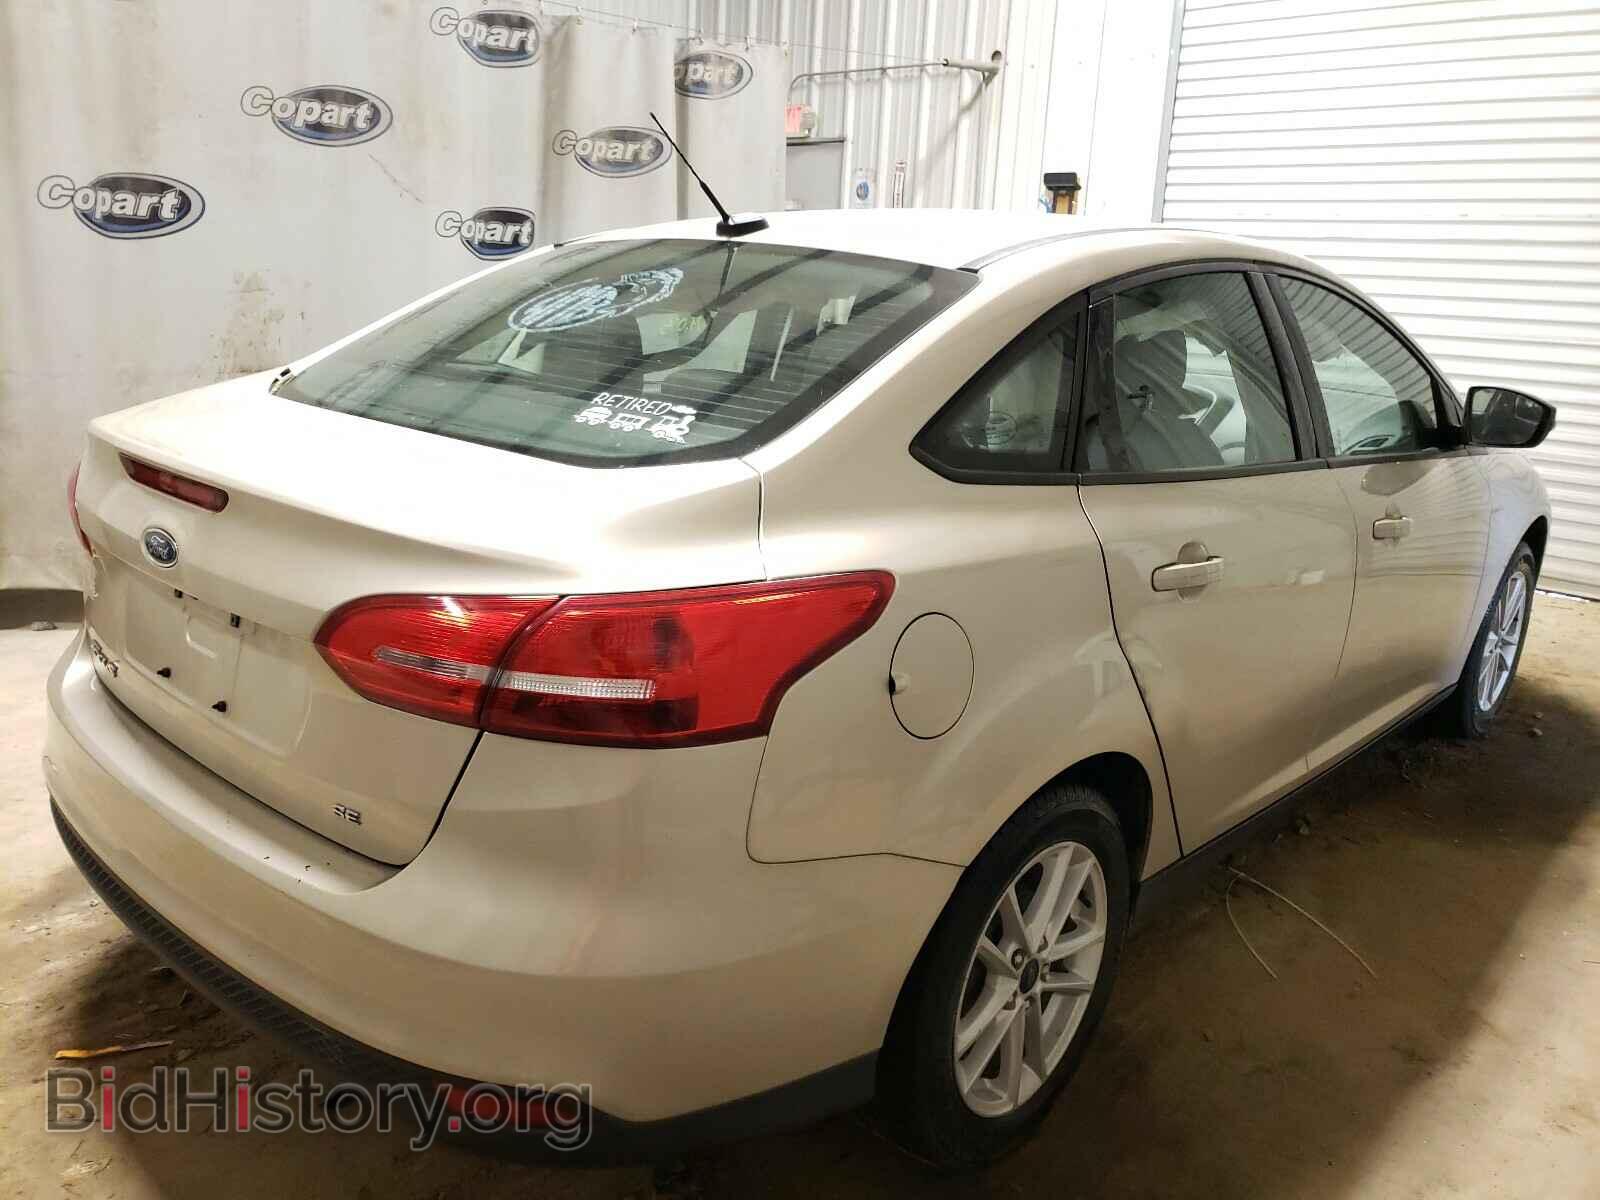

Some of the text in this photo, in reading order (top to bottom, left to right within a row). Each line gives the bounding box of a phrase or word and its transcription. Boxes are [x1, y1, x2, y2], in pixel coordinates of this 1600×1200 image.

[430, 6, 540, 53] Copart
[240, 85, 372, 130] Copart
[551, 129, 654, 163] Copart
[36, 174, 182, 222] Copart
[434, 210, 533, 245] Copart
[591, 392, 672, 416] RETIRED
